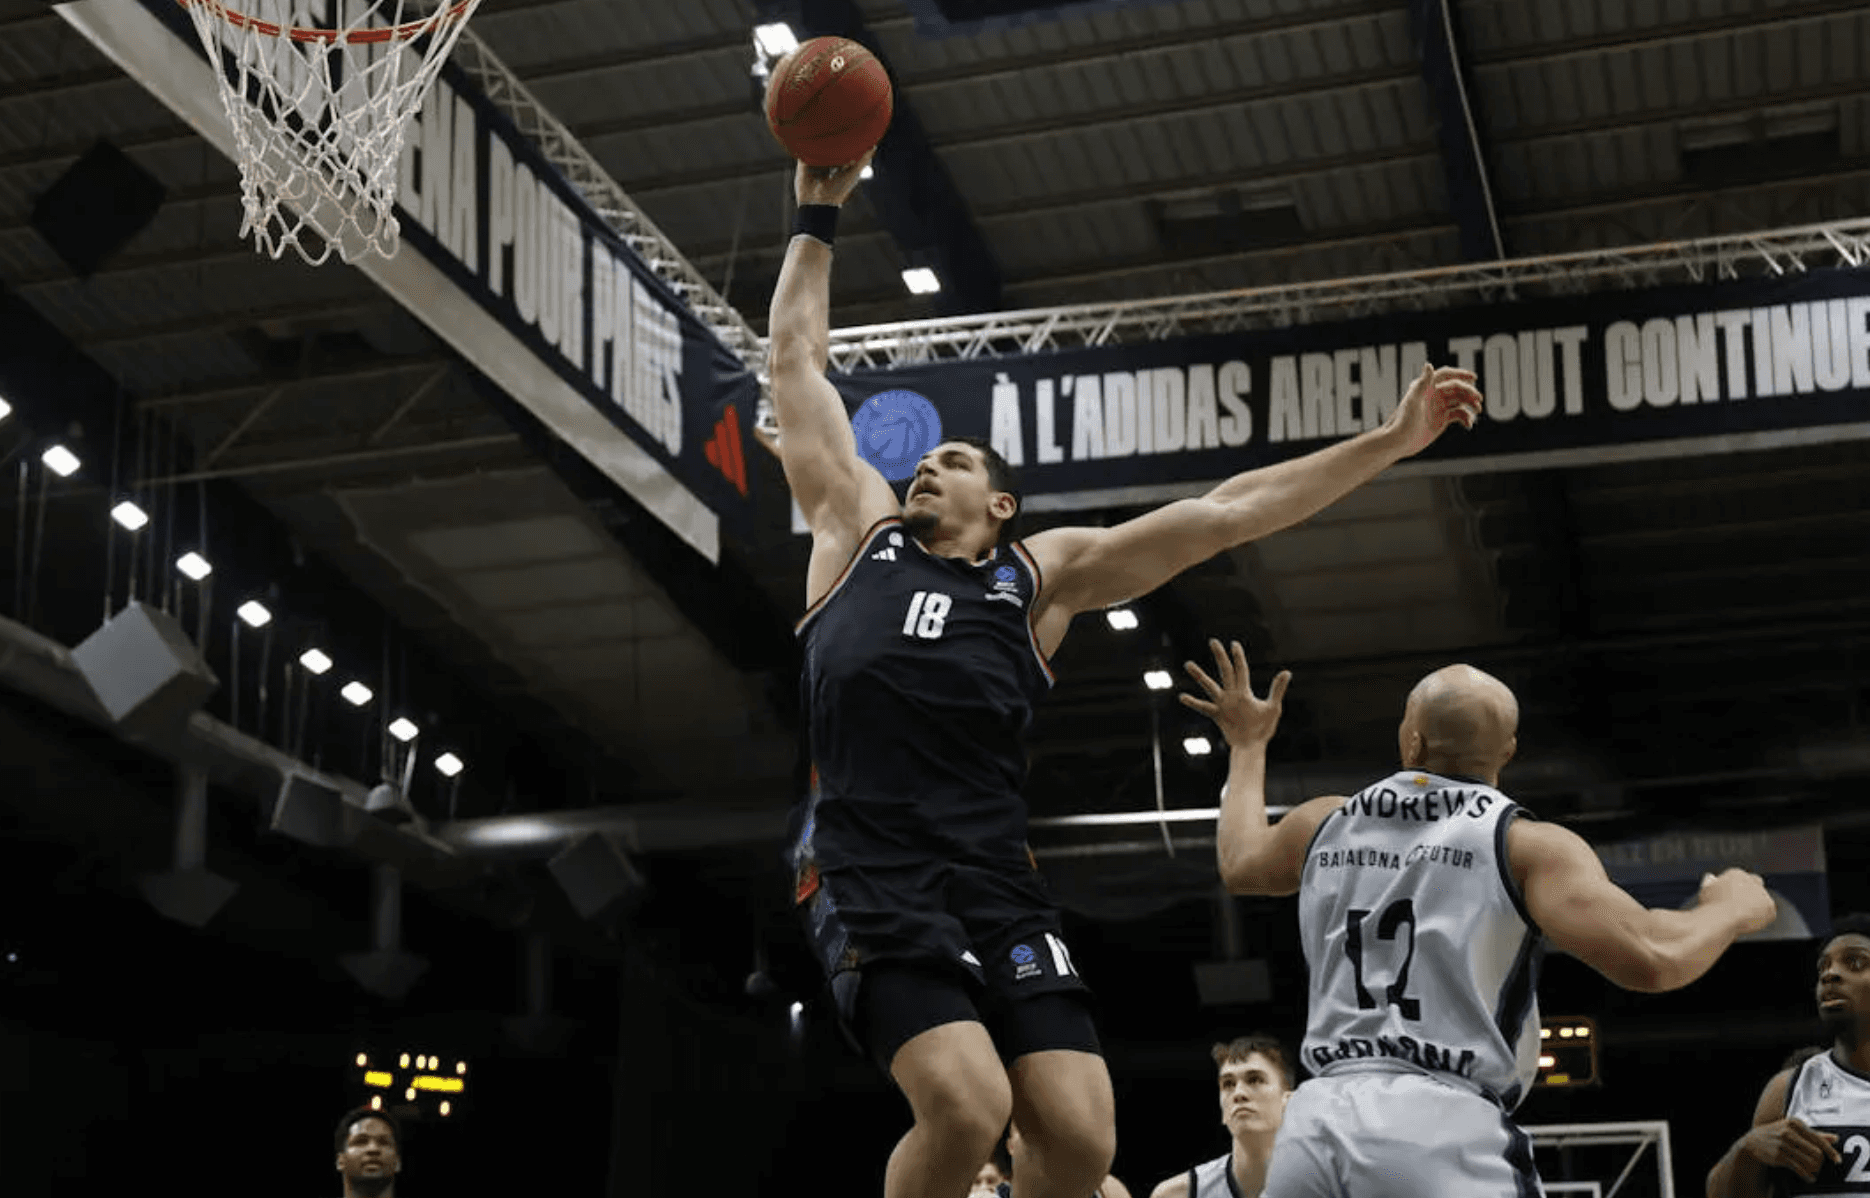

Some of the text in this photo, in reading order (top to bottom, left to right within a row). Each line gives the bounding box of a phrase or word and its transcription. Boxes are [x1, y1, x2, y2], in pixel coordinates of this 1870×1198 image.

[490, 130, 584, 371] POUR
[991, 372, 1024, 466] À
[1036, 360, 1252, 464] L'ADIDAS
[1448, 325, 1588, 421] TOUT
[1604, 295, 1870, 410] CONTINUE
[903, 591, 952, 640] 18
[1340, 787, 1493, 822] NDREWS
[1344, 898, 1421, 1021] 12
